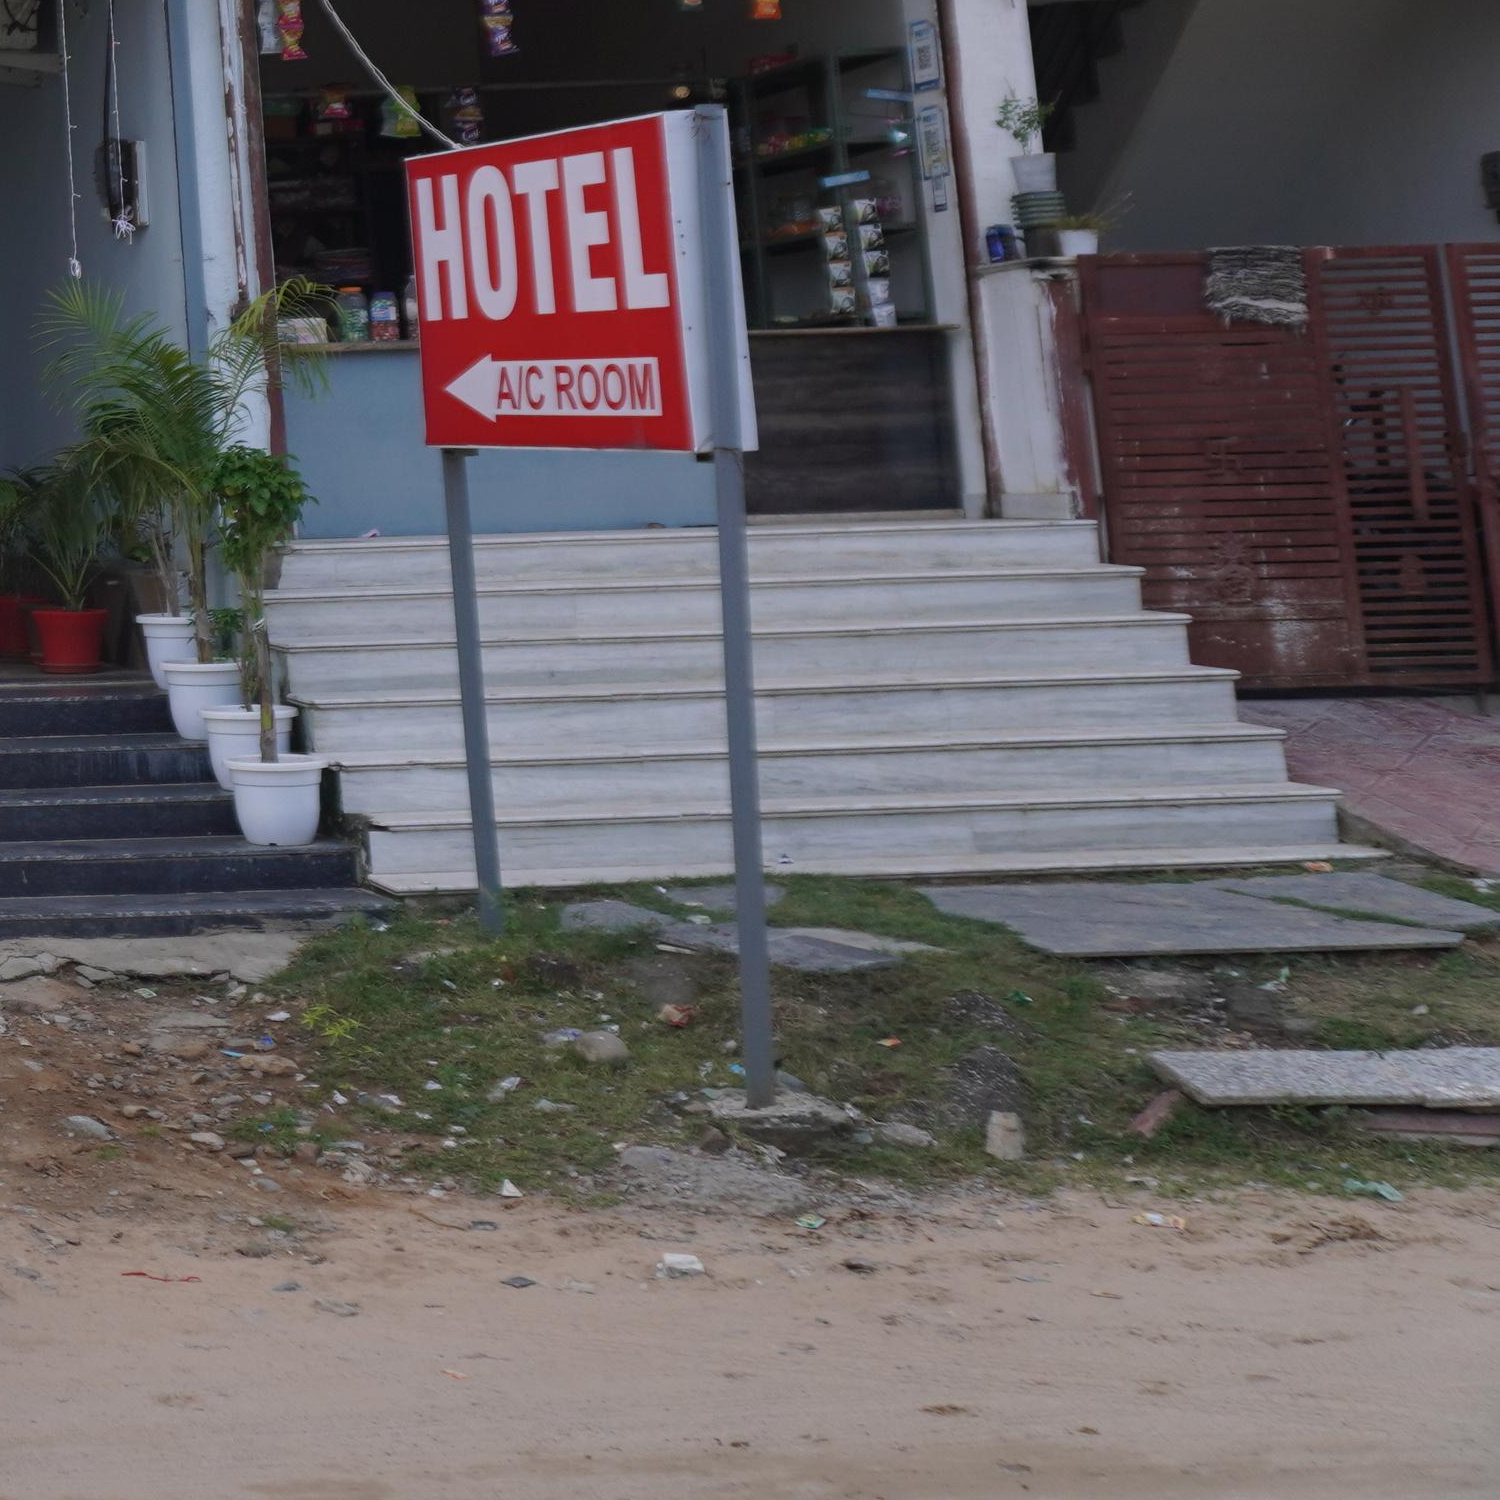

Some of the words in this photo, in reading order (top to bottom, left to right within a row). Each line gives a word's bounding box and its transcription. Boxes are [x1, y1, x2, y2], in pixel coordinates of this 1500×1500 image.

[416, 146, 671, 322] HOTEL
[496, 365, 546, 410] A/C
[554, 363, 656, 411] ROOM
